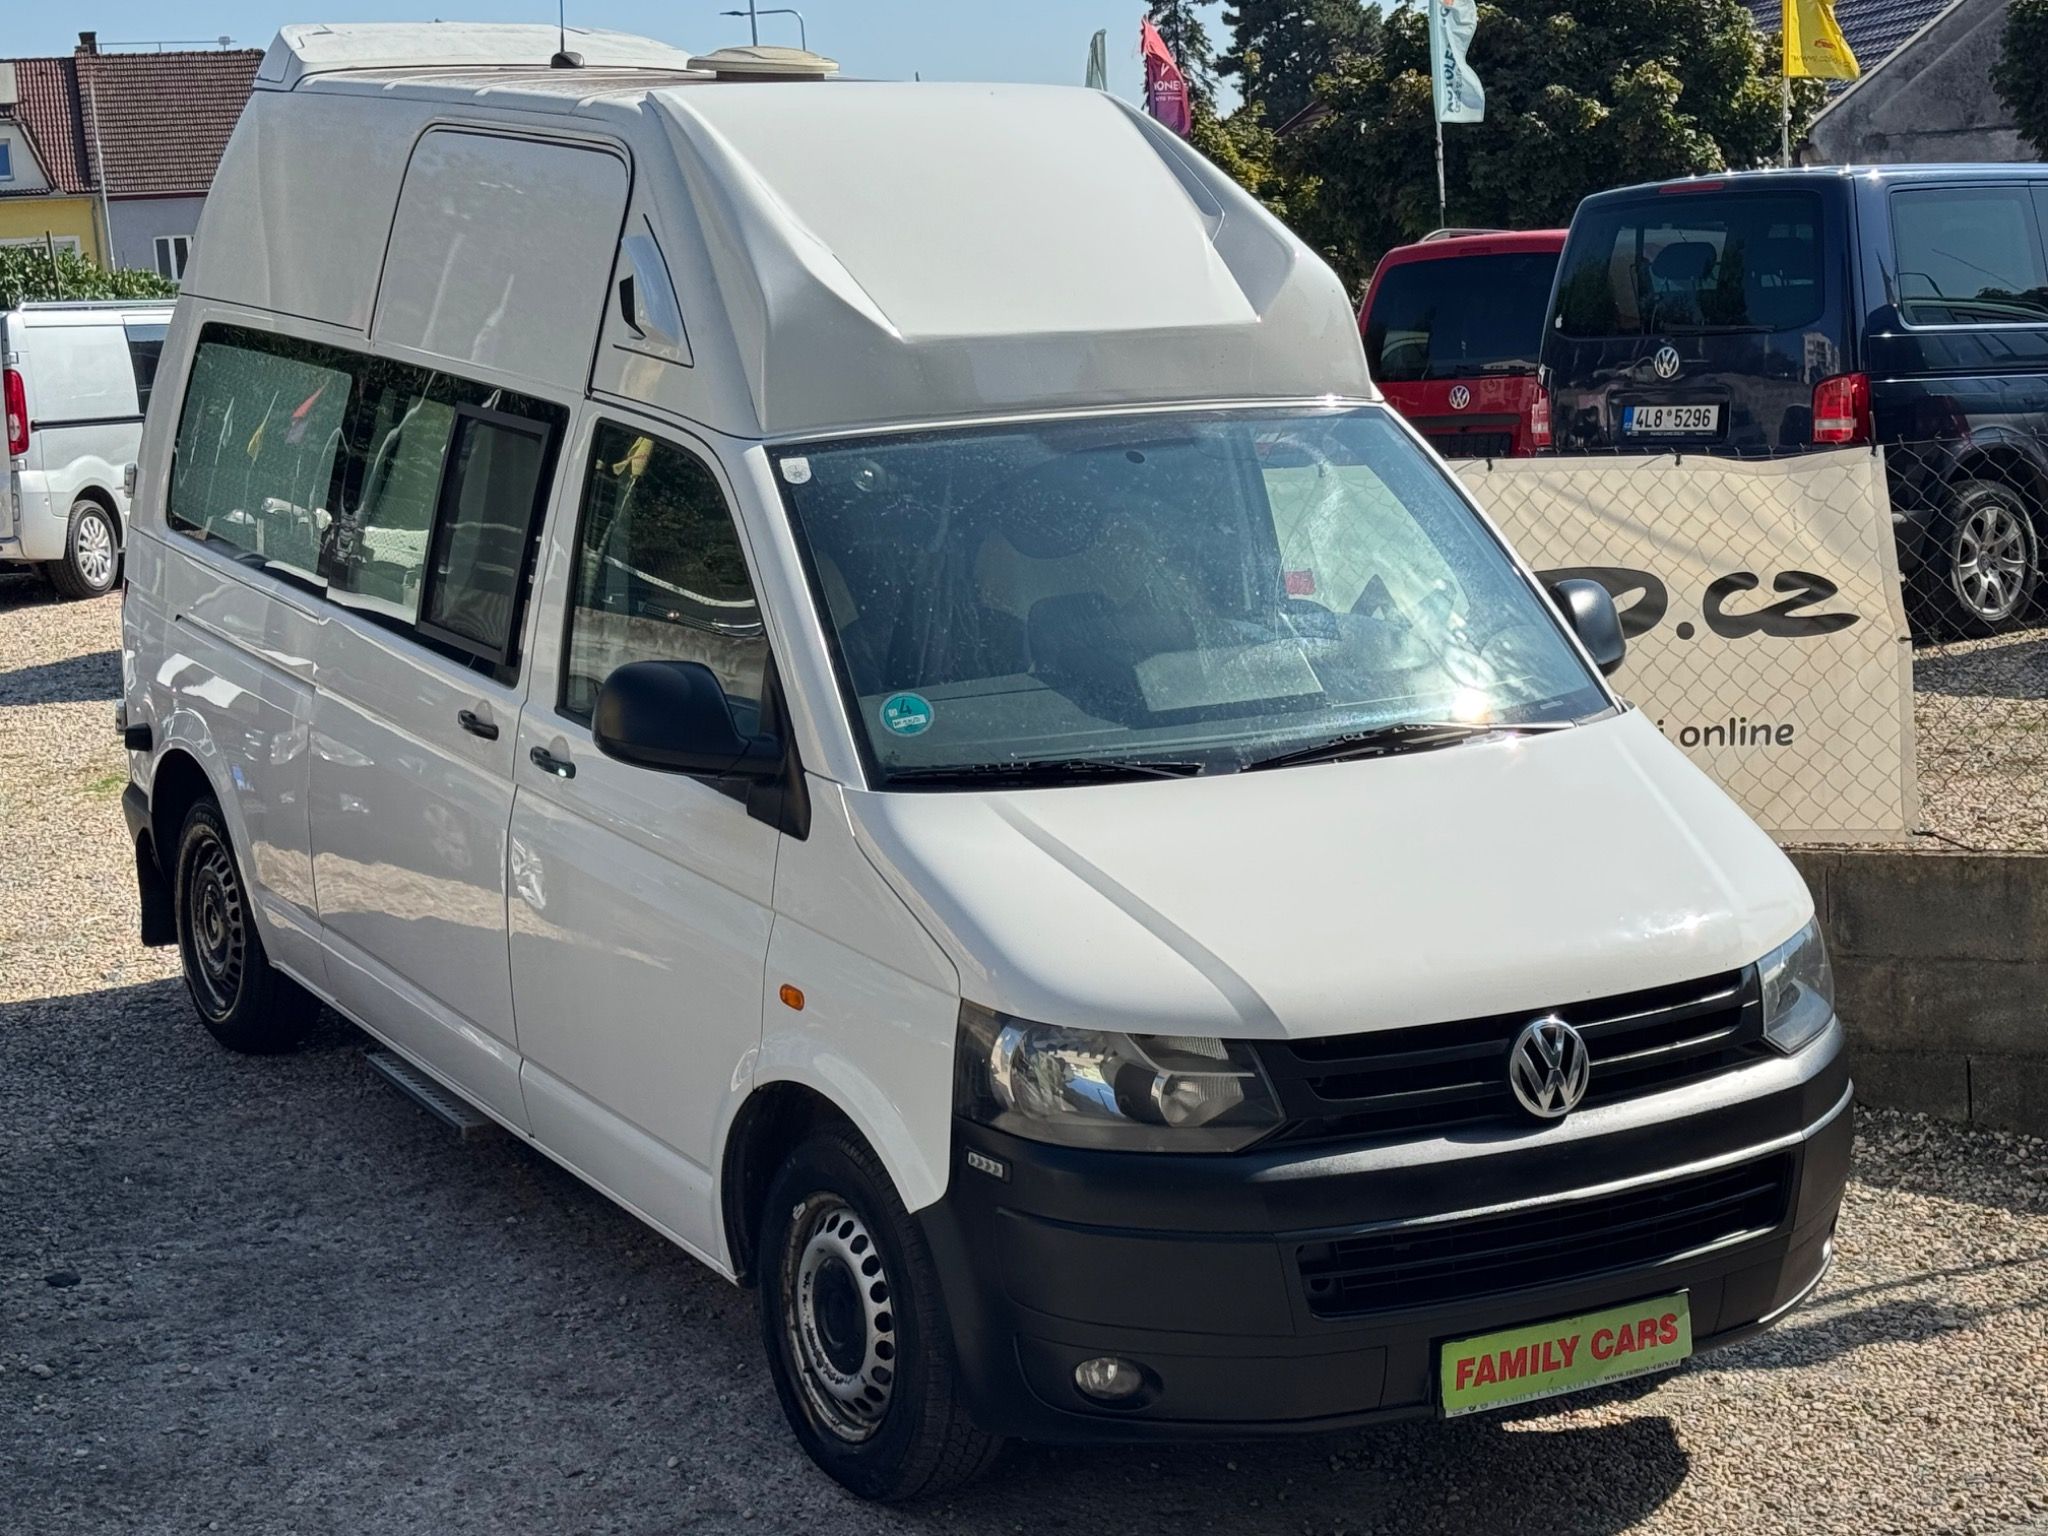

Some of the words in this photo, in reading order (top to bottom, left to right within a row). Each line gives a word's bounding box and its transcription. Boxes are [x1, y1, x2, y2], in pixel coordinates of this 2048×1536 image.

[1635, 409, 1663, 428] 4L8
[1674, 408, 1711, 428] 5296
[1679, 716, 1794, 748] online
[1510, 1017, 1590, 1118] VW
[1456, 1334, 1581, 1391] FAMILY
[1590, 1313, 1678, 1360] CARS
